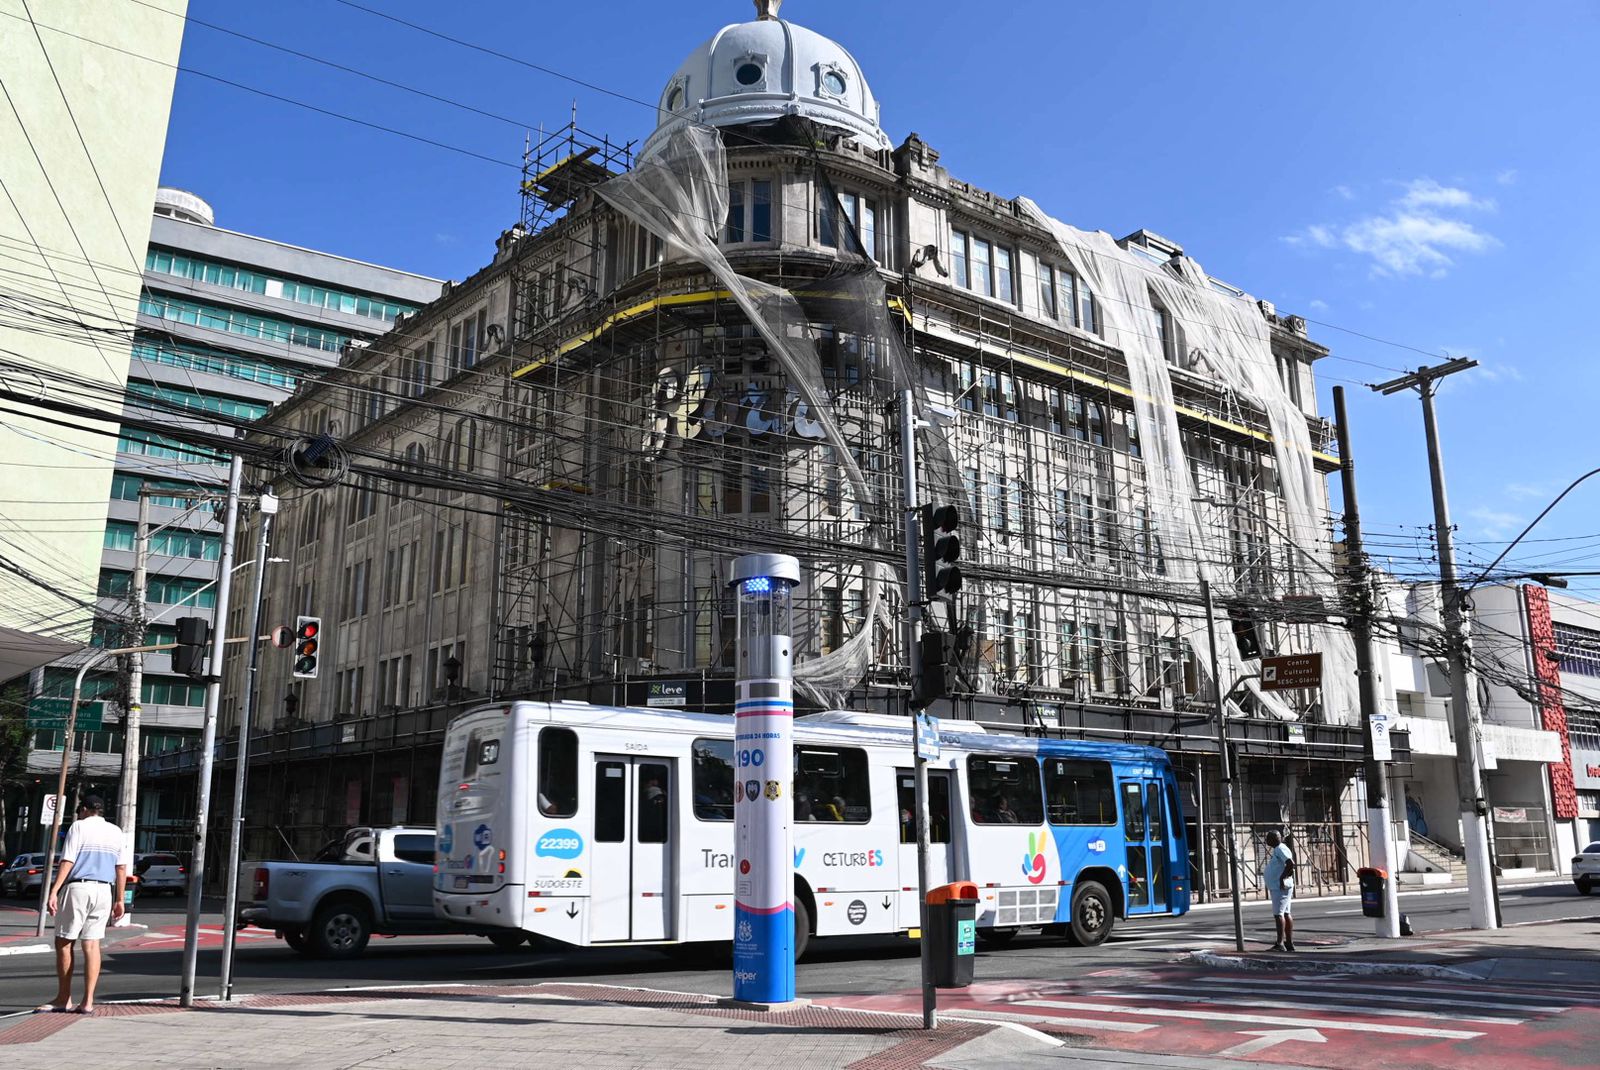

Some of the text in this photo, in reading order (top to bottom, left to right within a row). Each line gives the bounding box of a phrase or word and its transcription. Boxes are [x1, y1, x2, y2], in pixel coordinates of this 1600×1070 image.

[661, 684, 683, 695] leve
[737, 749, 764, 767] 190
[540, 838, 579, 849] 22399
[534, 879, 583, 889] SUDOESTE
